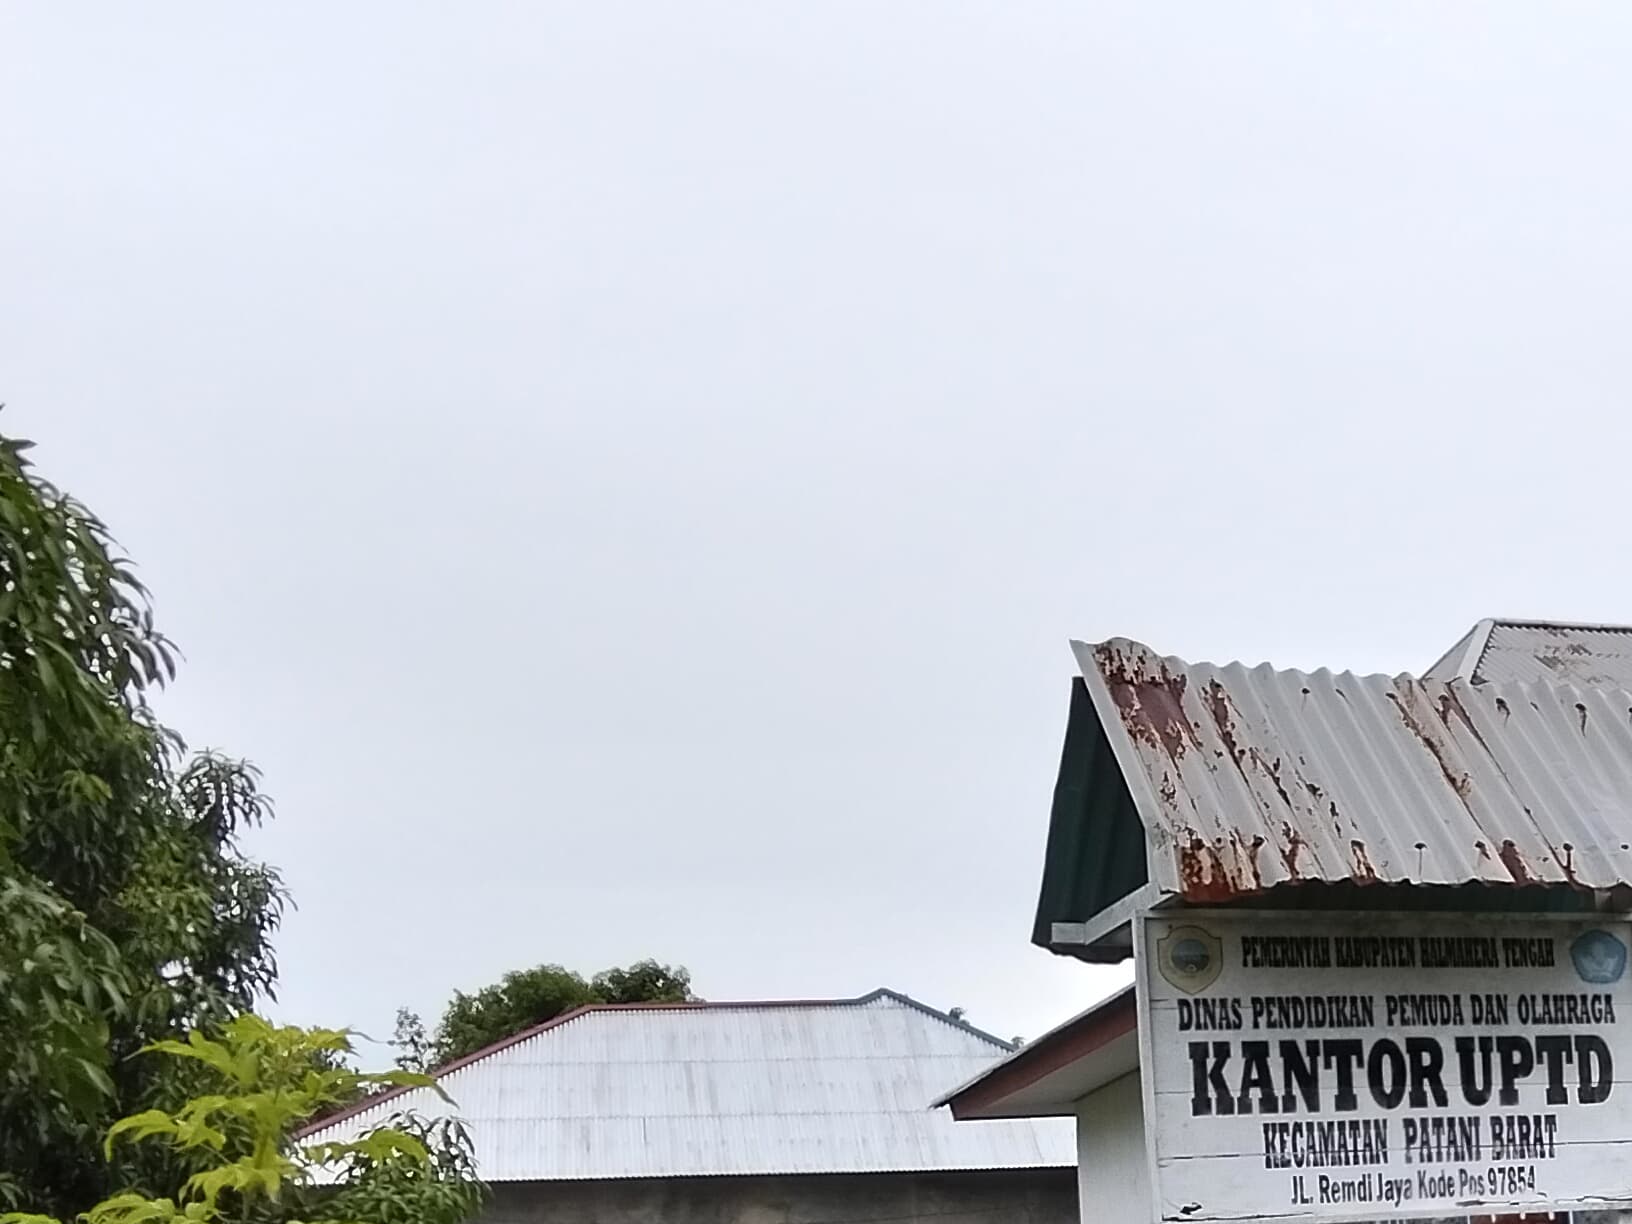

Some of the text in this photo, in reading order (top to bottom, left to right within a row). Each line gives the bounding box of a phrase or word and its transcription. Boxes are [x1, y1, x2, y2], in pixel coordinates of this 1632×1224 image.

[1241, 936, 1555, 968] PEMERINTAH KABUPATEN HALMAHERA TENGAH
[1178, 994, 1616, 1031] DINAS PENDIDIKAN PEMUDA DAN OLAHRAGA
[1188, 1034, 1614, 1116] KANTOR UPTD
[1263, 1114, 1557, 1168] KECAMATAN PATANI BARAT
[1291, 1165, 1535, 1207] JL. Remdi Jaya Kode Pos 97854
